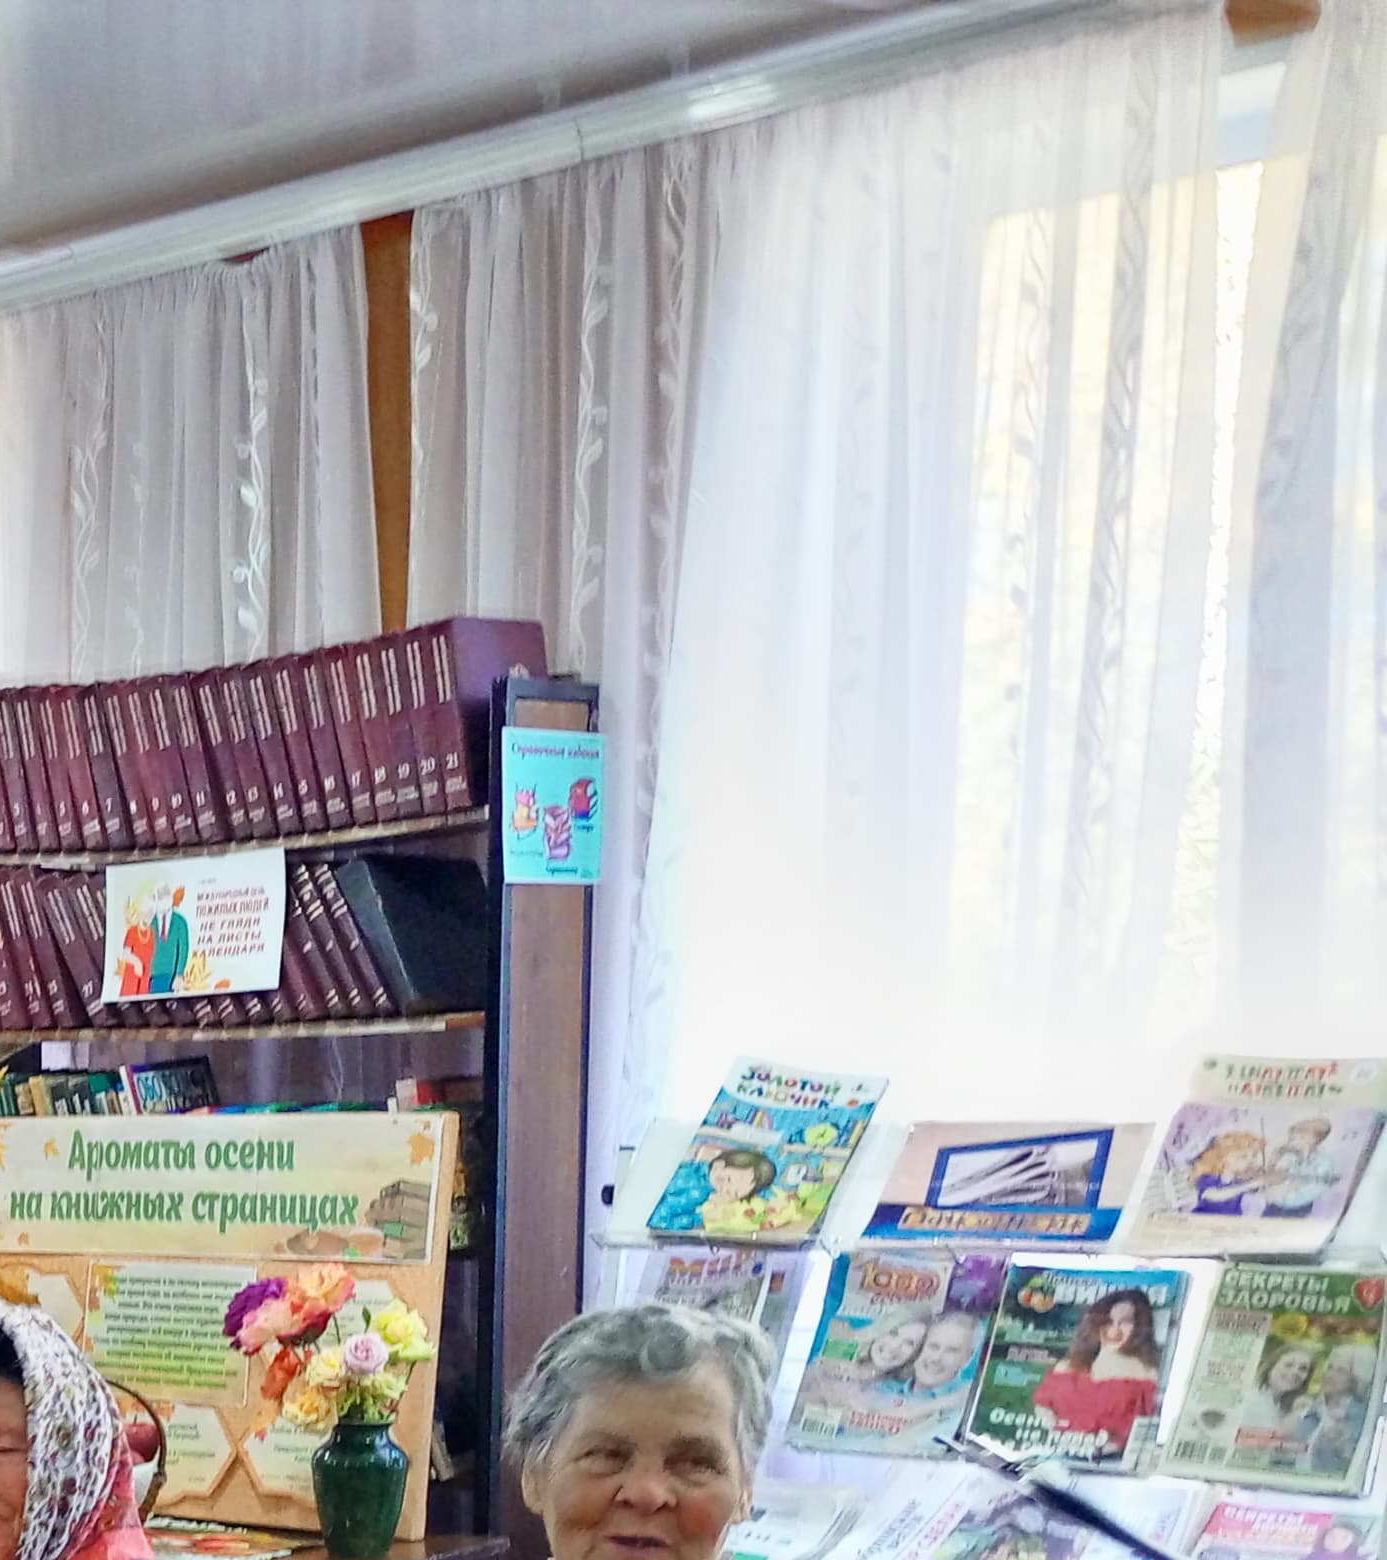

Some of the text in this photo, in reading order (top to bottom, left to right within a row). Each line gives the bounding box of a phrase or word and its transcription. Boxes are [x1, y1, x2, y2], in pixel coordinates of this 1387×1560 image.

[198, 931, 261, 945] НА ЛИСТЫ
[68, 1129, 296, 1181] Ароматы осени
[10, 1191, 359, 1234] на книжных страницах
[1225, 1270, 1329, 1292] СЕКРЕТЫ
[1055, 1283, 1168, 1306] ВИЯ
[1220, 1288, 1351, 1314] ЗДОРОВЬЯ
